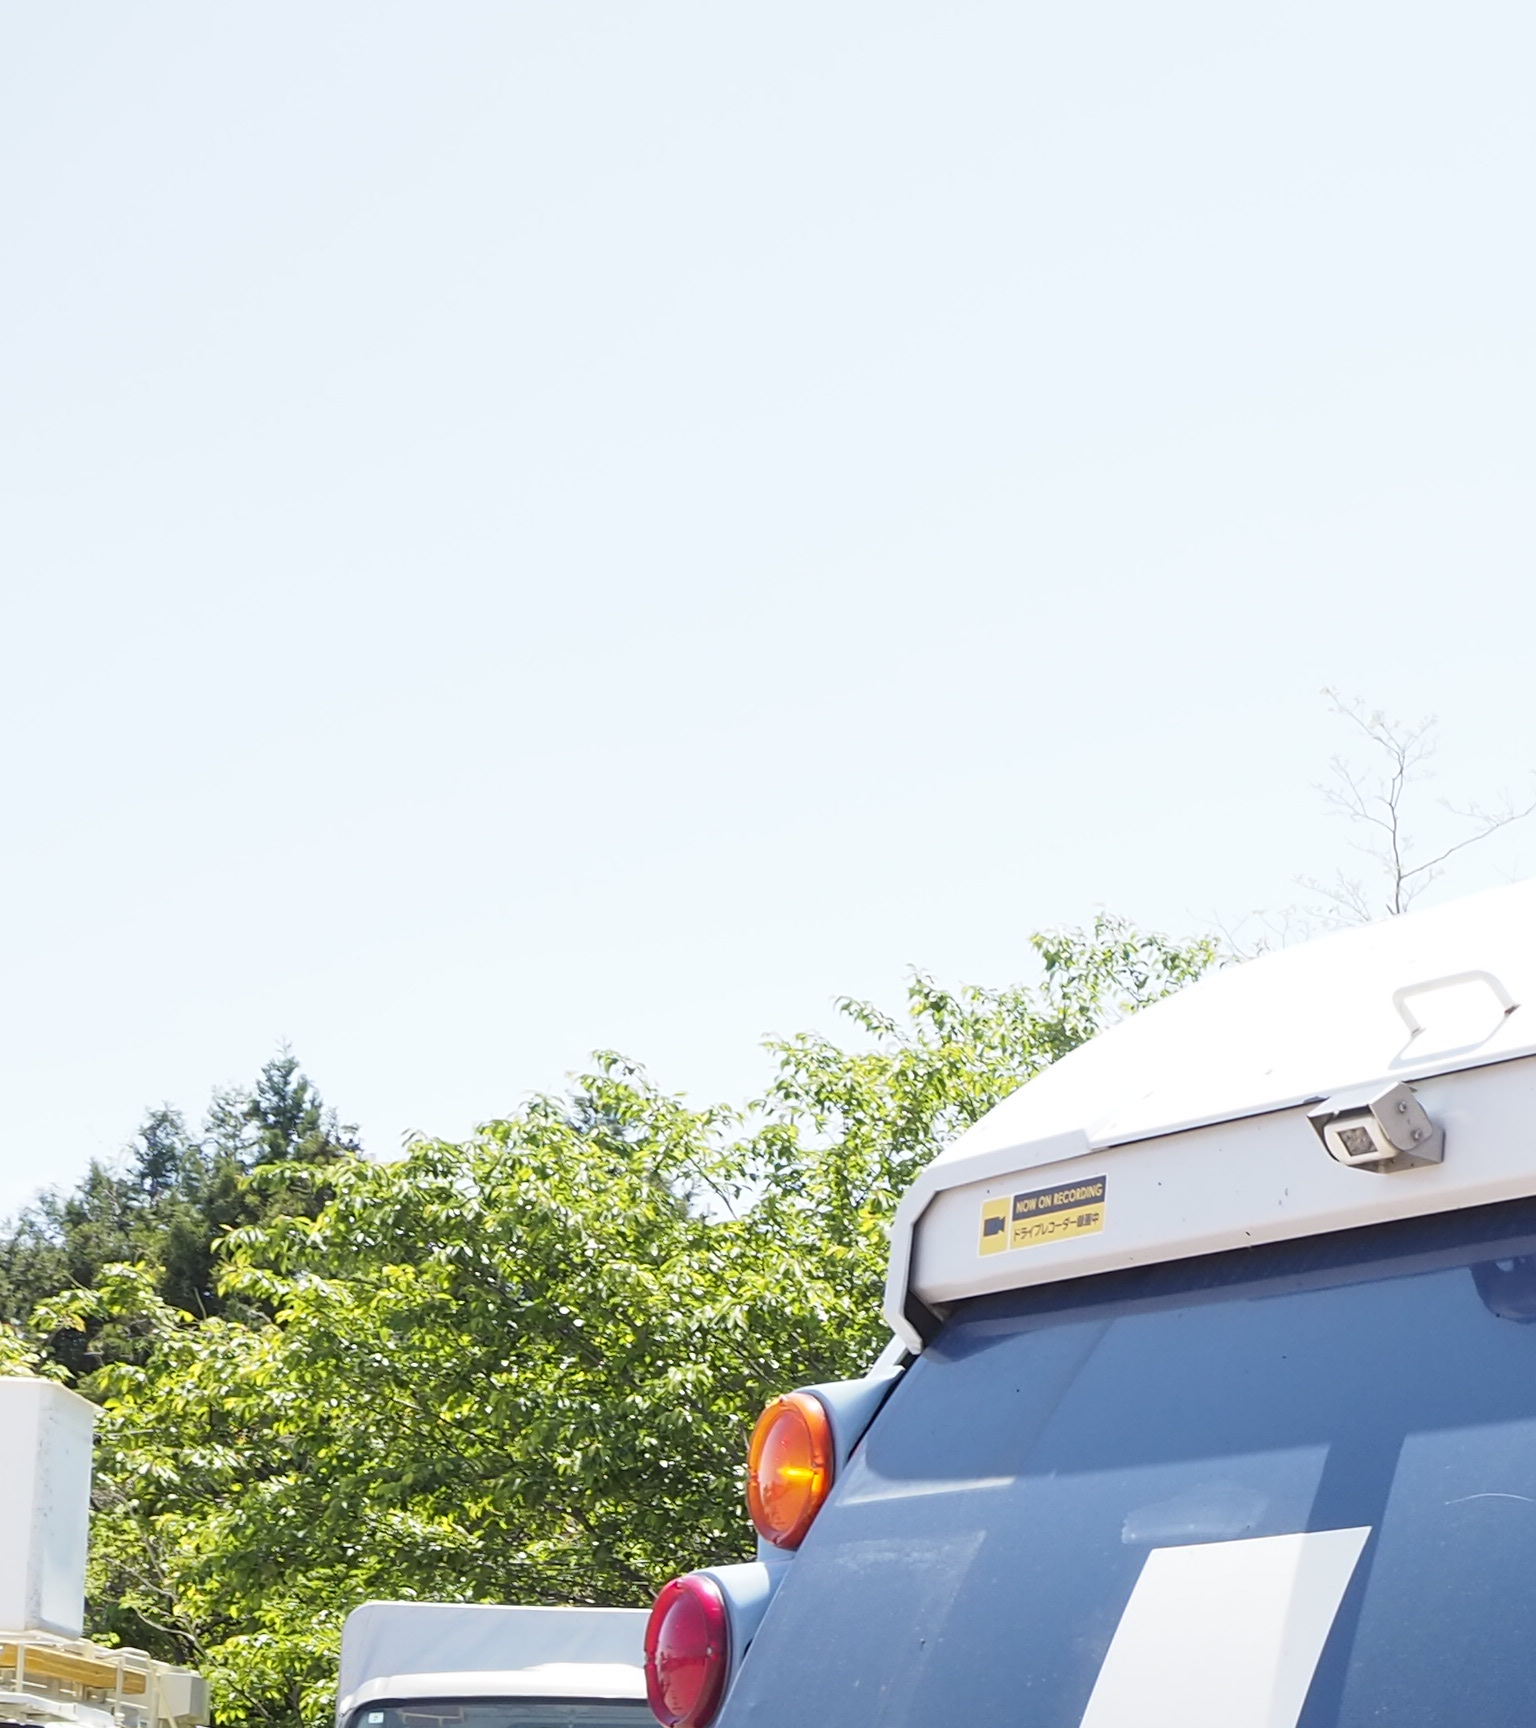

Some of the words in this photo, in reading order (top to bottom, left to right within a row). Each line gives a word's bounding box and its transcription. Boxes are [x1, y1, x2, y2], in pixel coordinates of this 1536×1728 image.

[1015, 1200, 1036, 1214] NOW
[1038, 1194, 1053, 1209] ON
[1053, 1183, 1103, 1206] RECORDING
